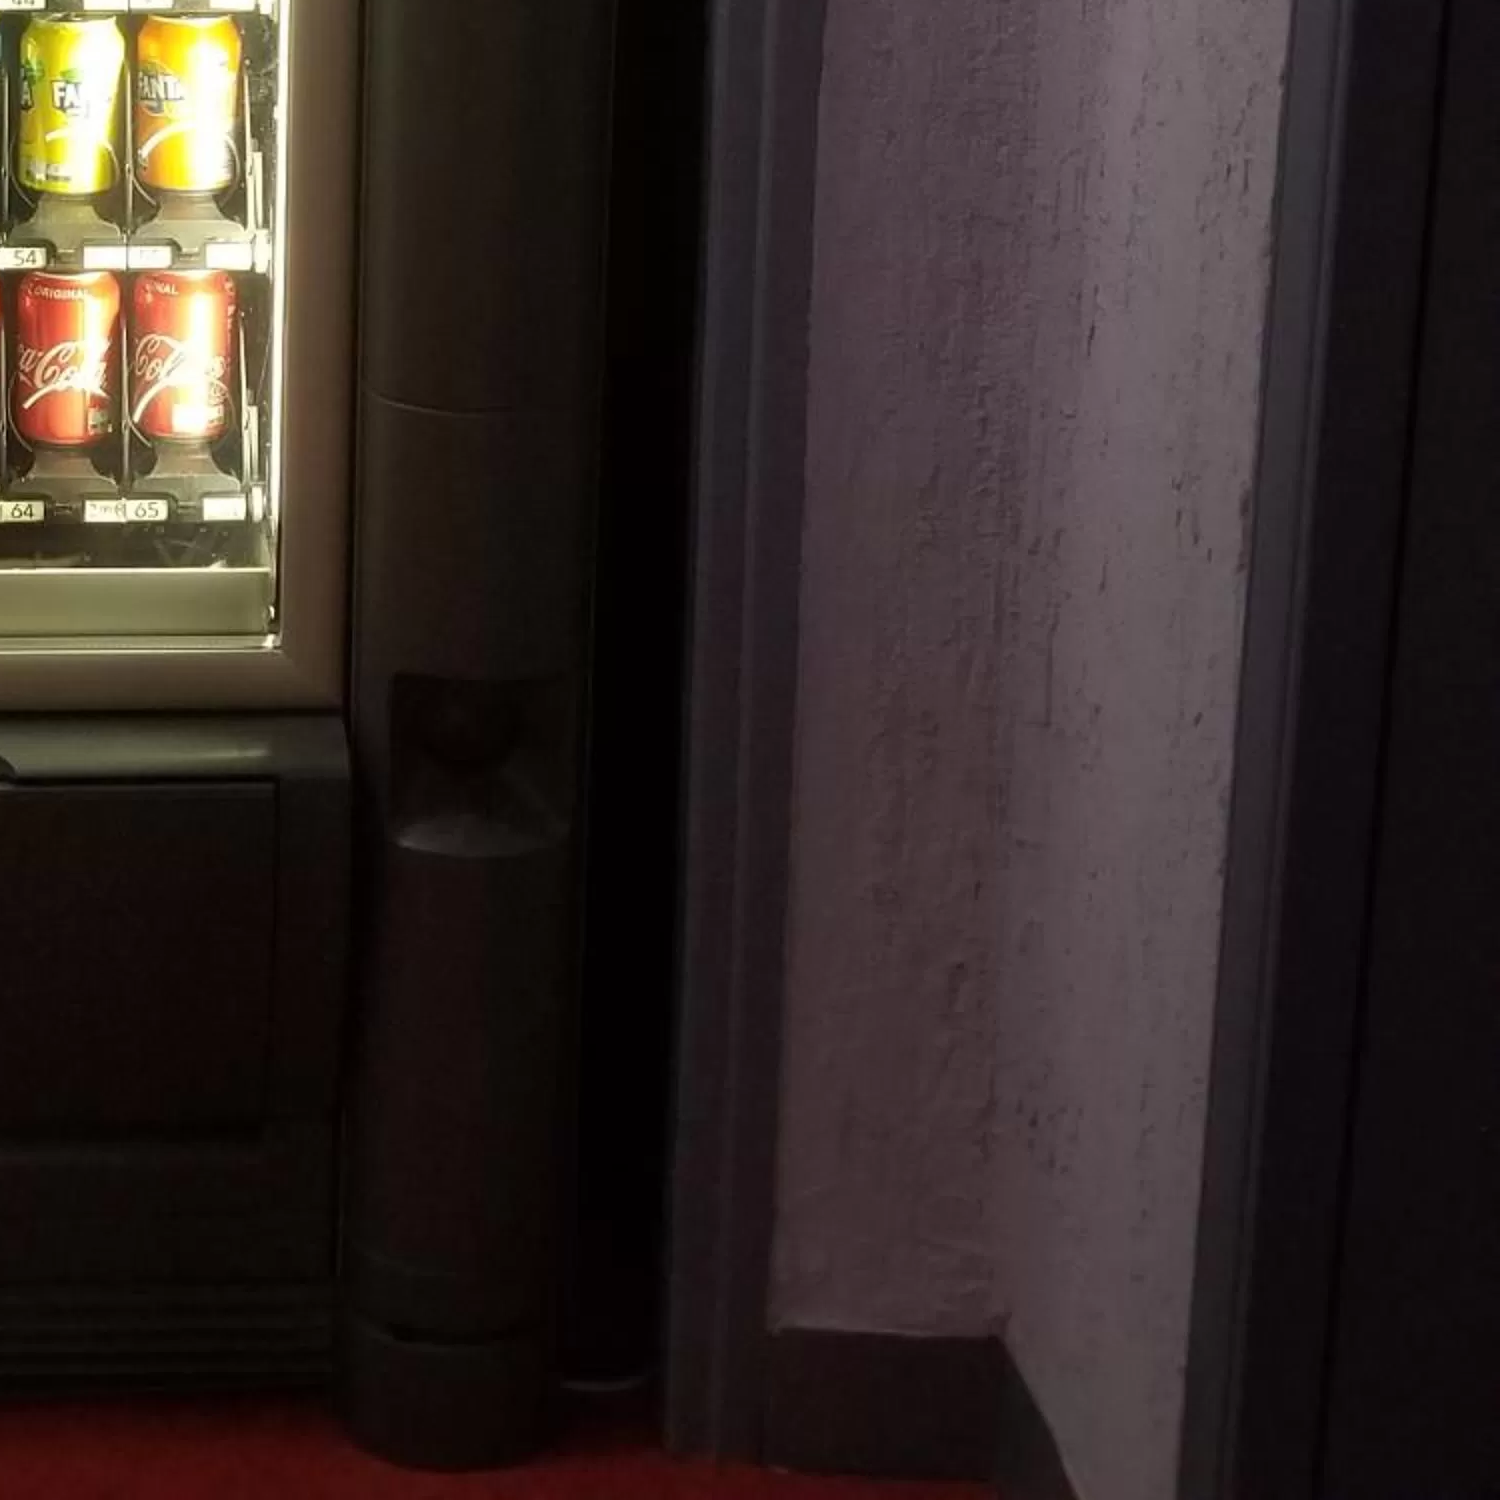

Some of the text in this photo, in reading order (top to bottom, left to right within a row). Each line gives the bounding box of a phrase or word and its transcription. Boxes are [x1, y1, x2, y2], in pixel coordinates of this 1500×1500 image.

[13, 250, 37, 266] 54
[10, 503, 34, 519] 64
[134, 501, 159, 519] 65
